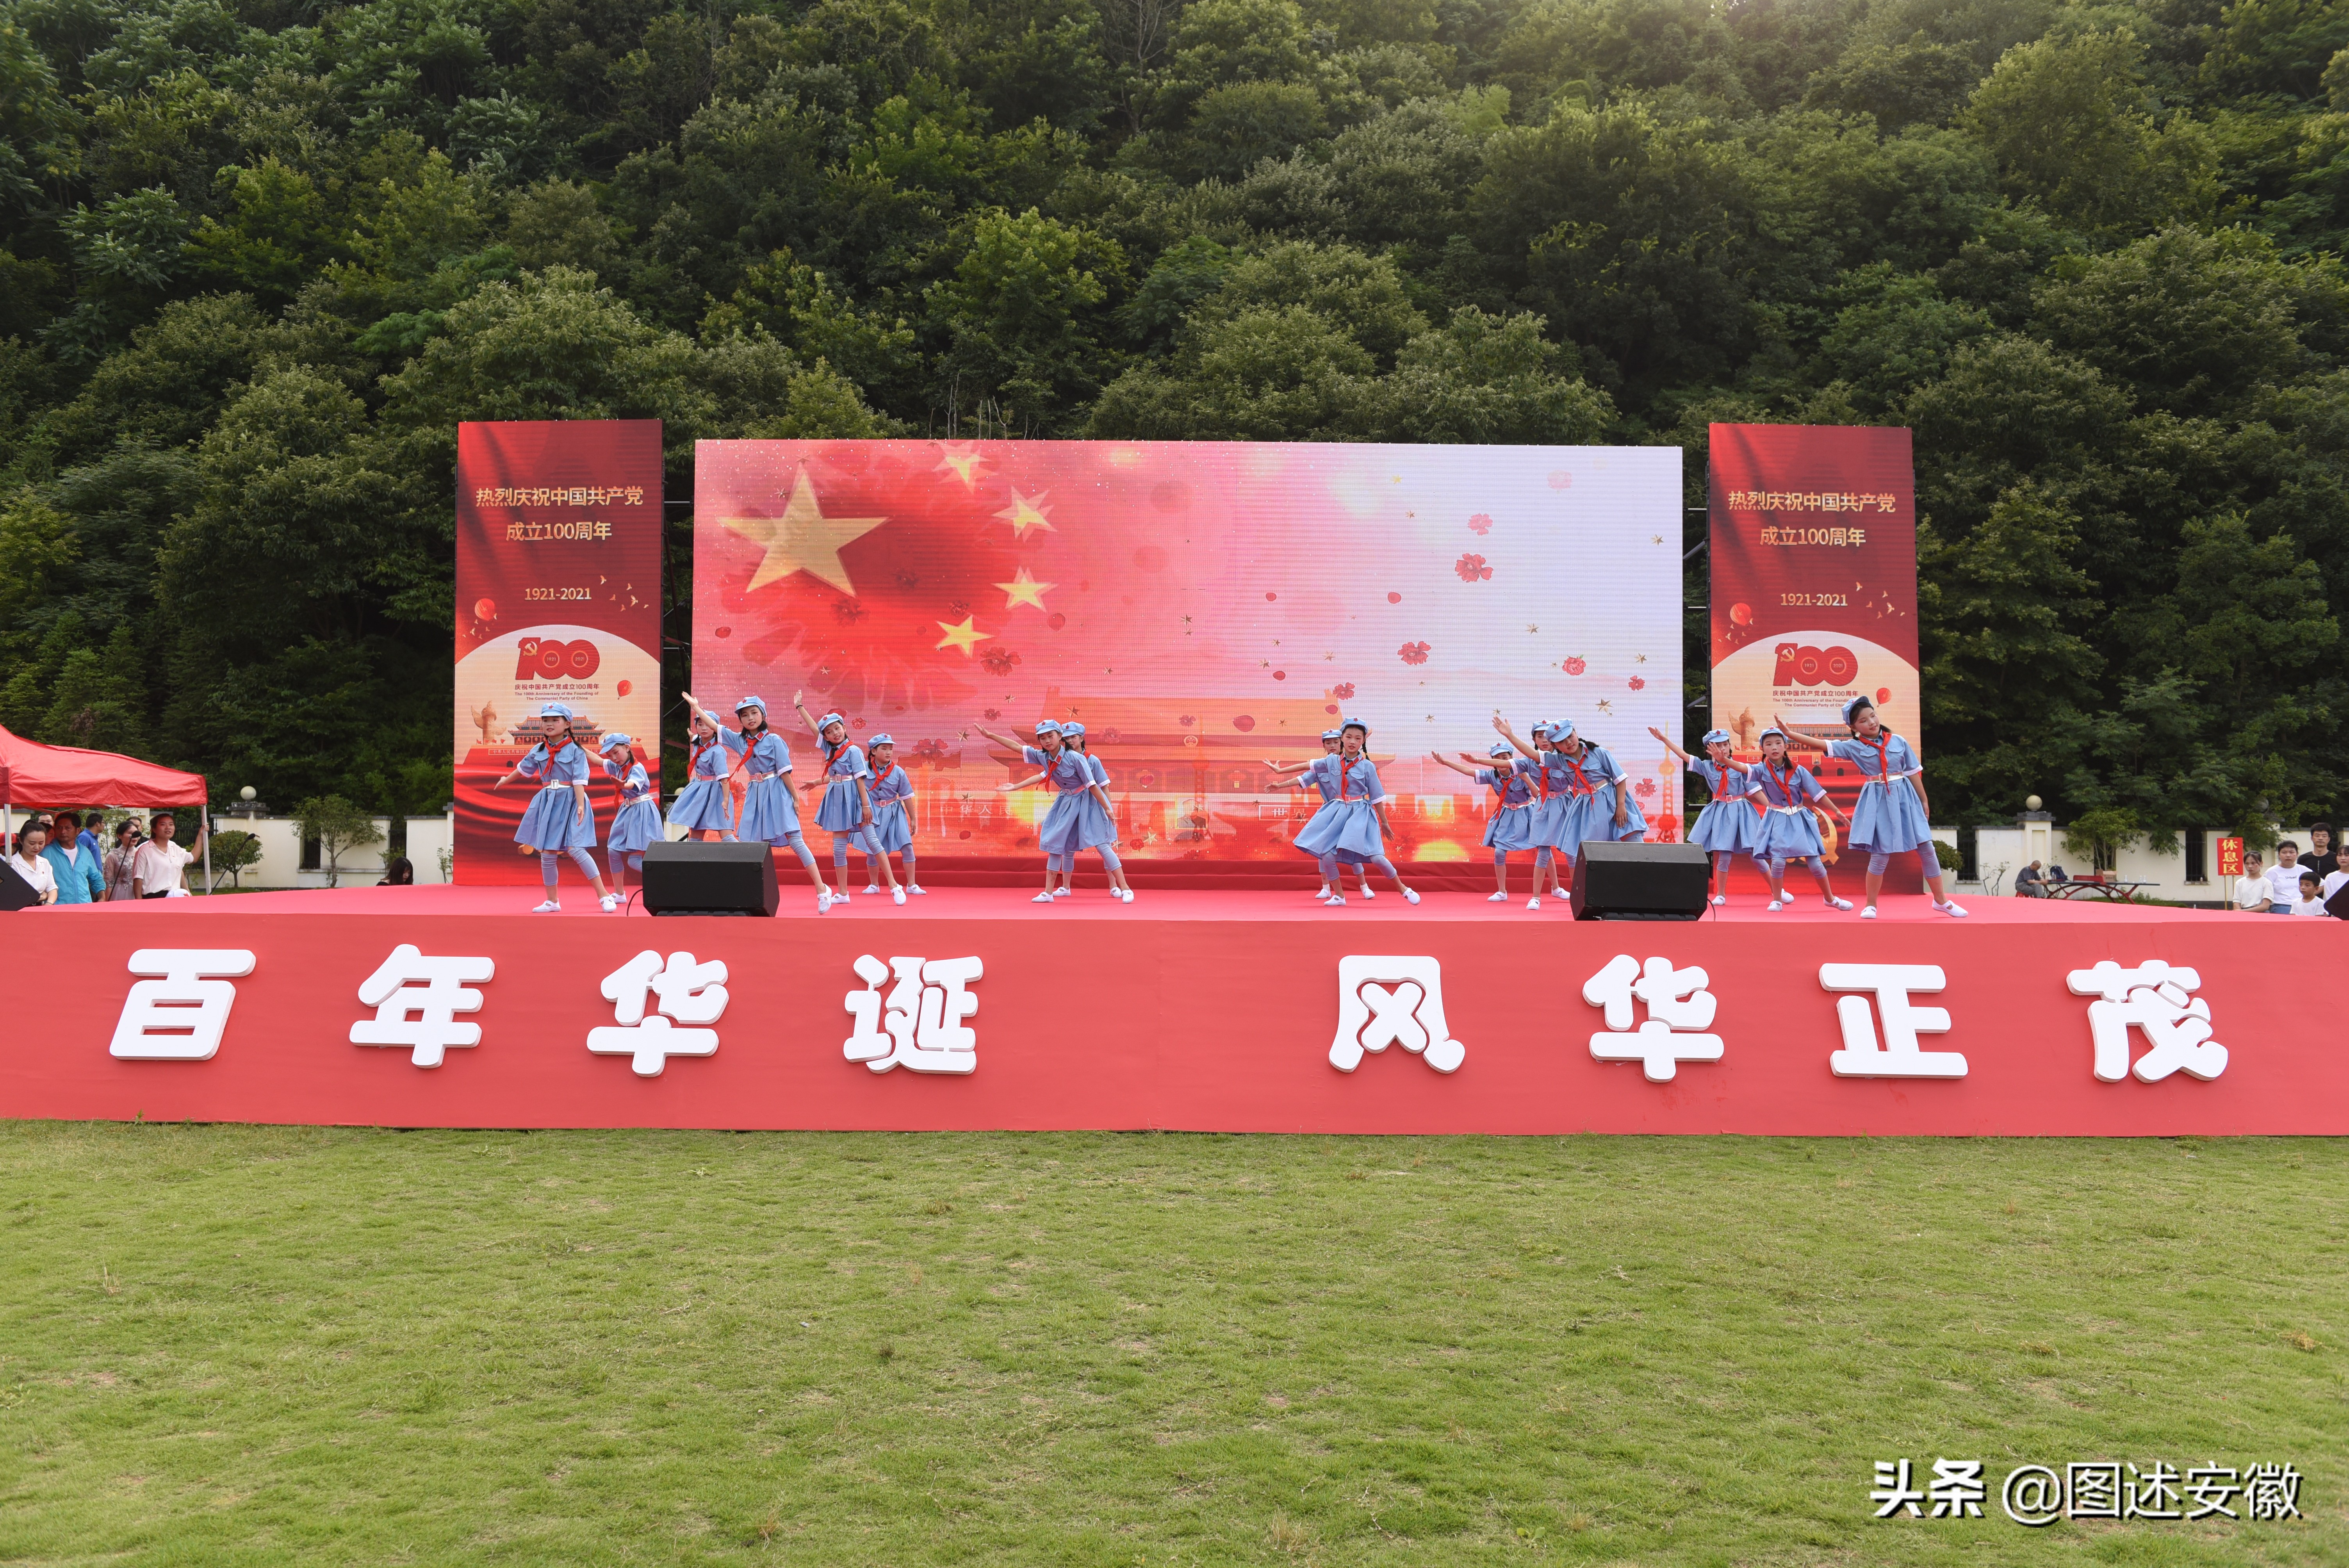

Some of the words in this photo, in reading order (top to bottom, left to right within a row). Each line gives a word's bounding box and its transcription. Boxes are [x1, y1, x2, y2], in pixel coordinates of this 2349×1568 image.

[476, 486, 643, 507] 热烈庆祝中国共产党
[1728, 490, 1896, 512] 热烈庆祝中国共产党
[506, 521, 612, 541] 成立100周年
[1760, 526, 1866, 546] 成立100周年
[525, 588, 592, 600] 1921-2021
[1780, 593, 1848, 606] 1921-2021
[515, 637, 600, 680] 100
[1773, 643, 1858, 686] 100
[2222, 839, 2239, 874] 休息区
[110, 944, 984, 1074] 百年华诞
[1329, 955, 2228, 1080] 风华正茂
